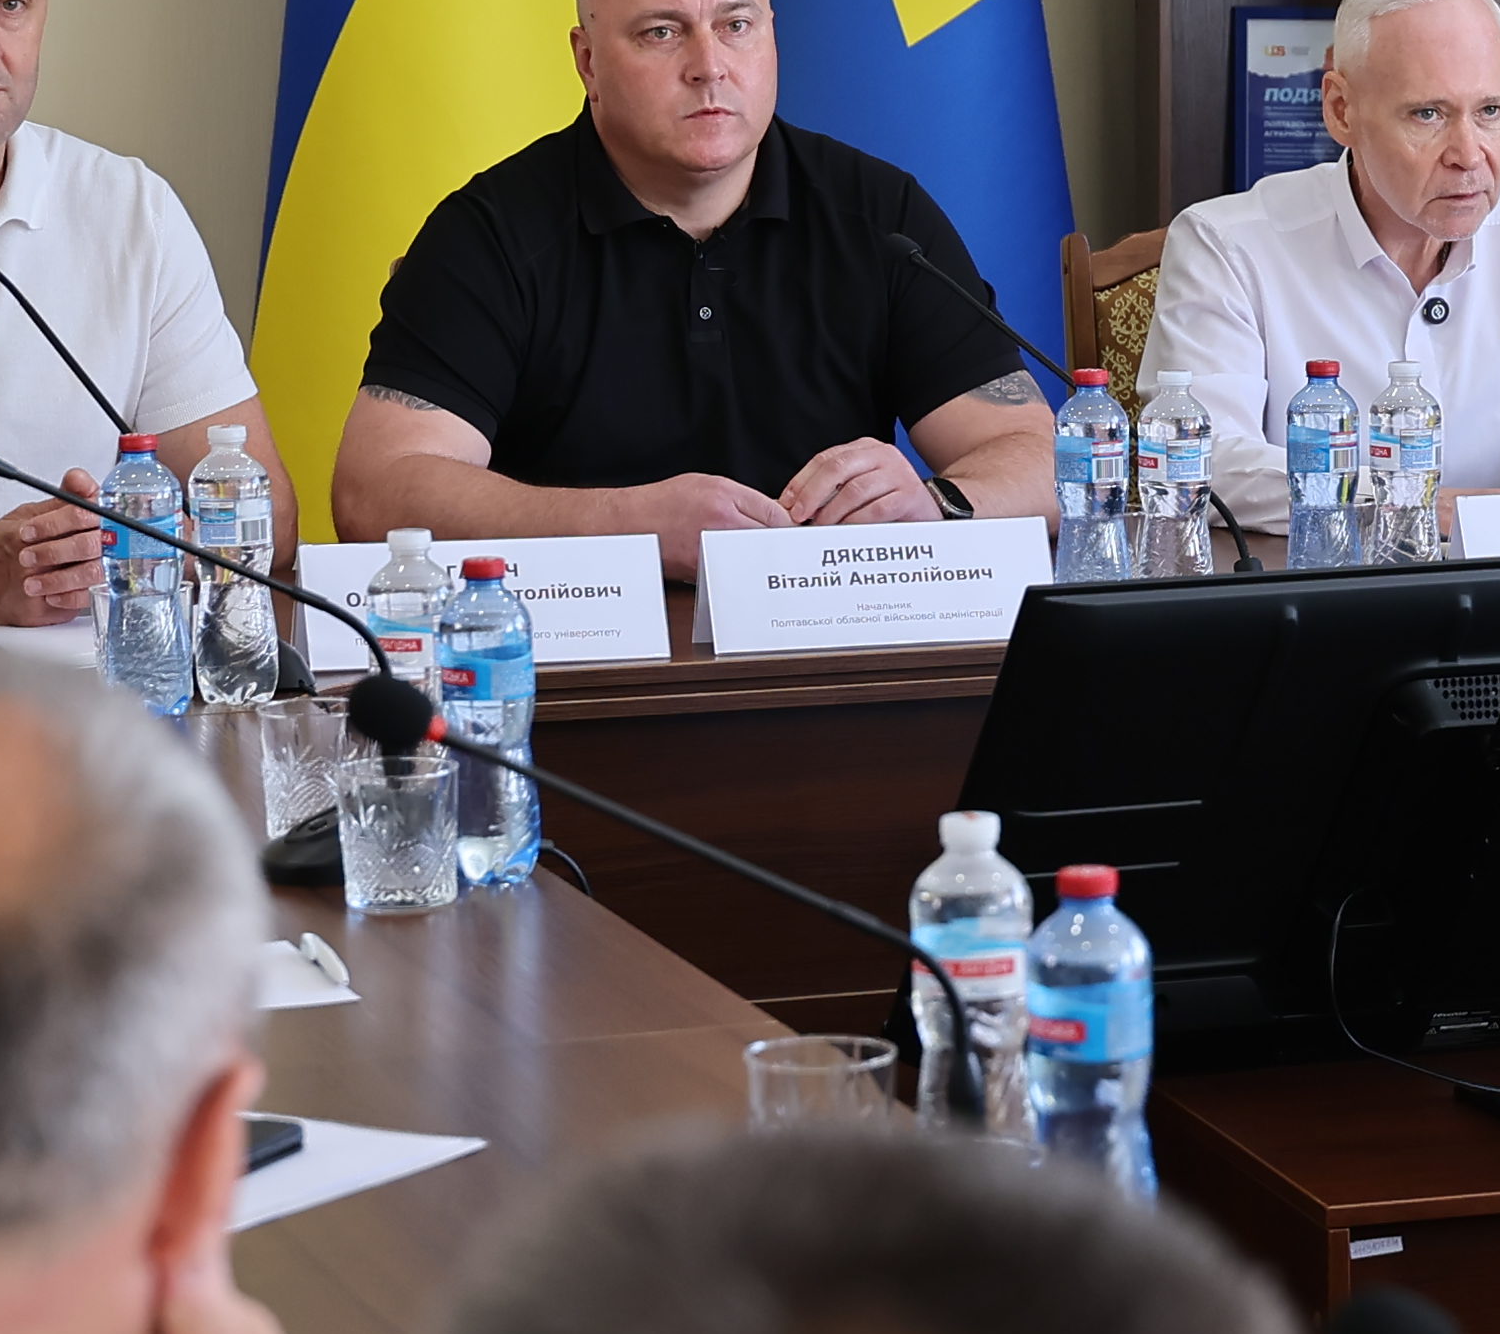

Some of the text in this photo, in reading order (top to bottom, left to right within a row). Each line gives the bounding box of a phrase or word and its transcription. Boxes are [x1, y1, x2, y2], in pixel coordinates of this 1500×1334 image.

[1263, 87, 1322, 105] ПОДЯ
[821, 544, 934, 567] ДЯКІВНИЧ
[767, 566, 994, 590] Віталій Анатолійович
[856, 601, 913, 612] Начальник
[770, 608, 1004, 629] Полтавської обласної військової адміністрації
[553, 628, 622, 640] університету
